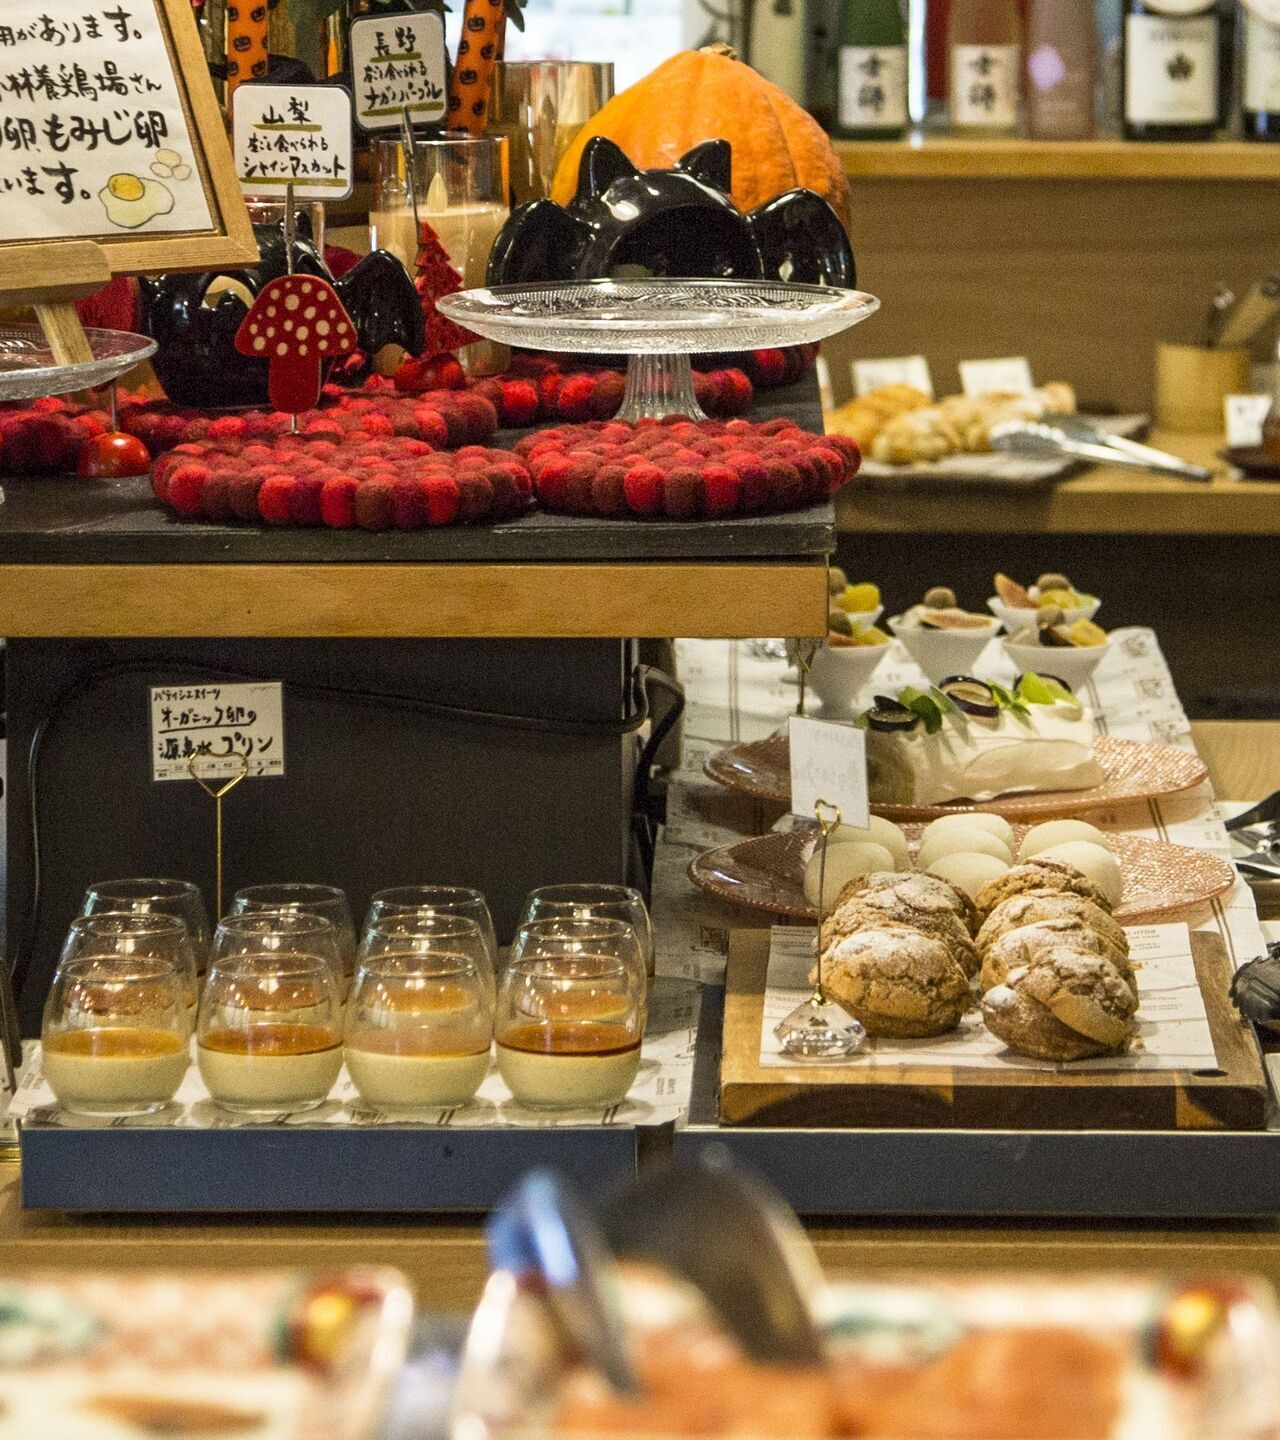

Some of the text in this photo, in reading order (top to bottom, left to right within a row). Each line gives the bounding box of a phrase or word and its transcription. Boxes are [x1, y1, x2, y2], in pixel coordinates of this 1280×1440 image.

[374, 26, 417, 57] 長野
[364, 79, 444, 110] ナガノパープル
[261, 96, 312, 125] 山梨
[242, 153, 346, 178] シャインマスカット
[154, 688, 221, 701] パティシエスイーツ
[161, 704, 258, 728] オーガニック卵の
